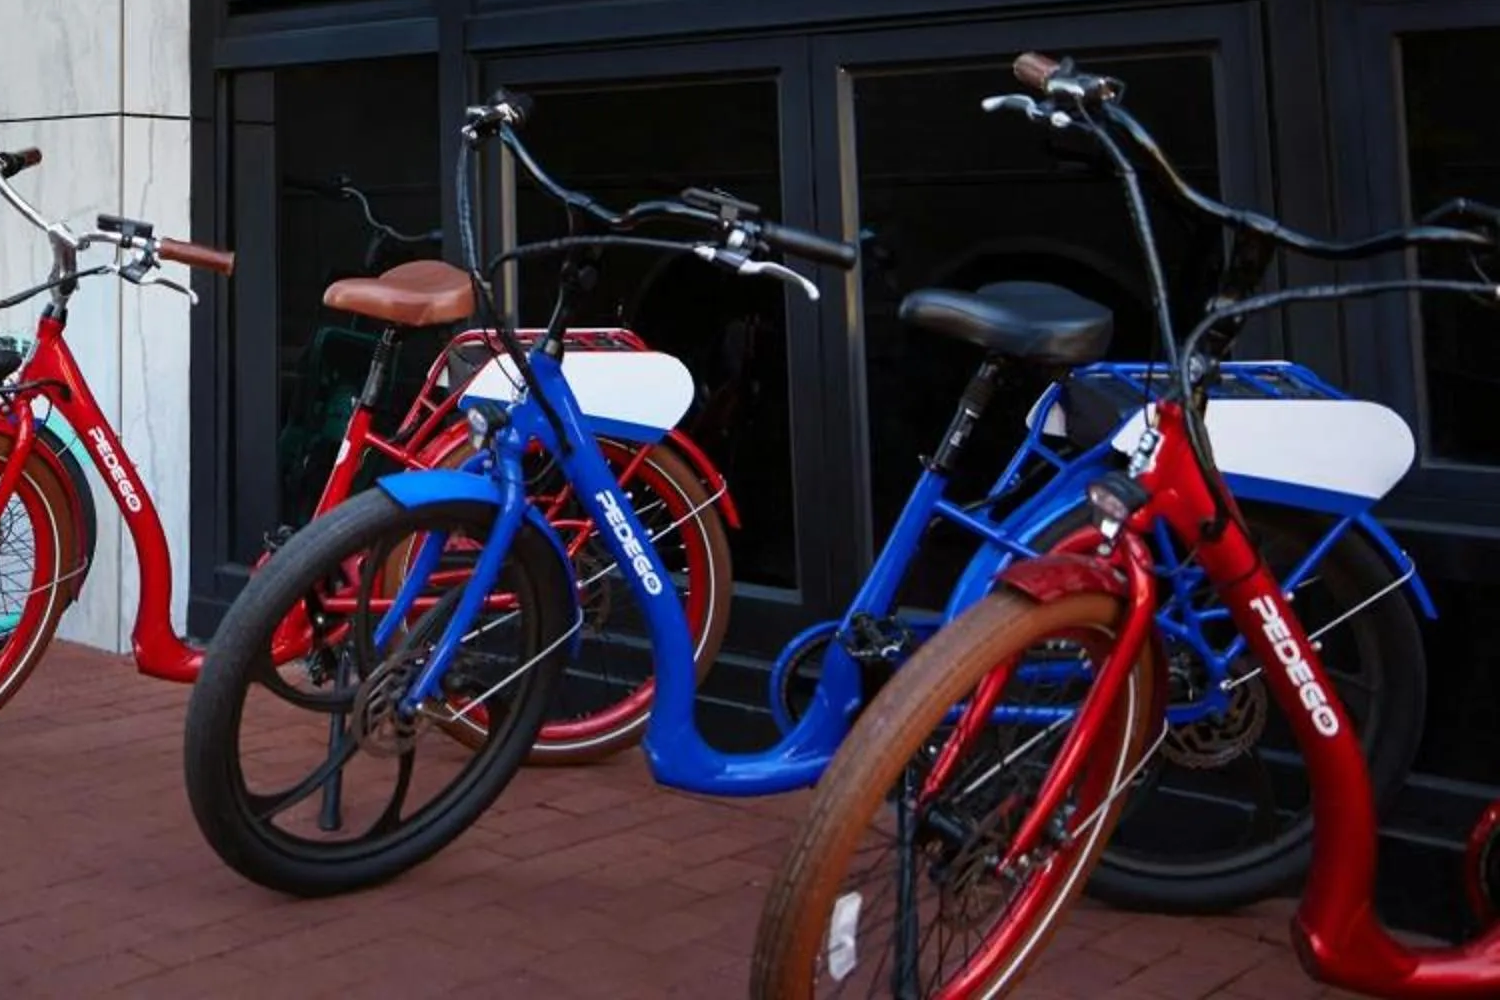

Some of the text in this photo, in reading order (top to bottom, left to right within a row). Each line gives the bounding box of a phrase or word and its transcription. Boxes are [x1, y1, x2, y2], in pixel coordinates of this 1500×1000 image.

[88, 425, 142, 513] PEDEGO
[595, 489, 663, 596] PEDEGO
[1249, 594, 1340, 737] PEDEGO
